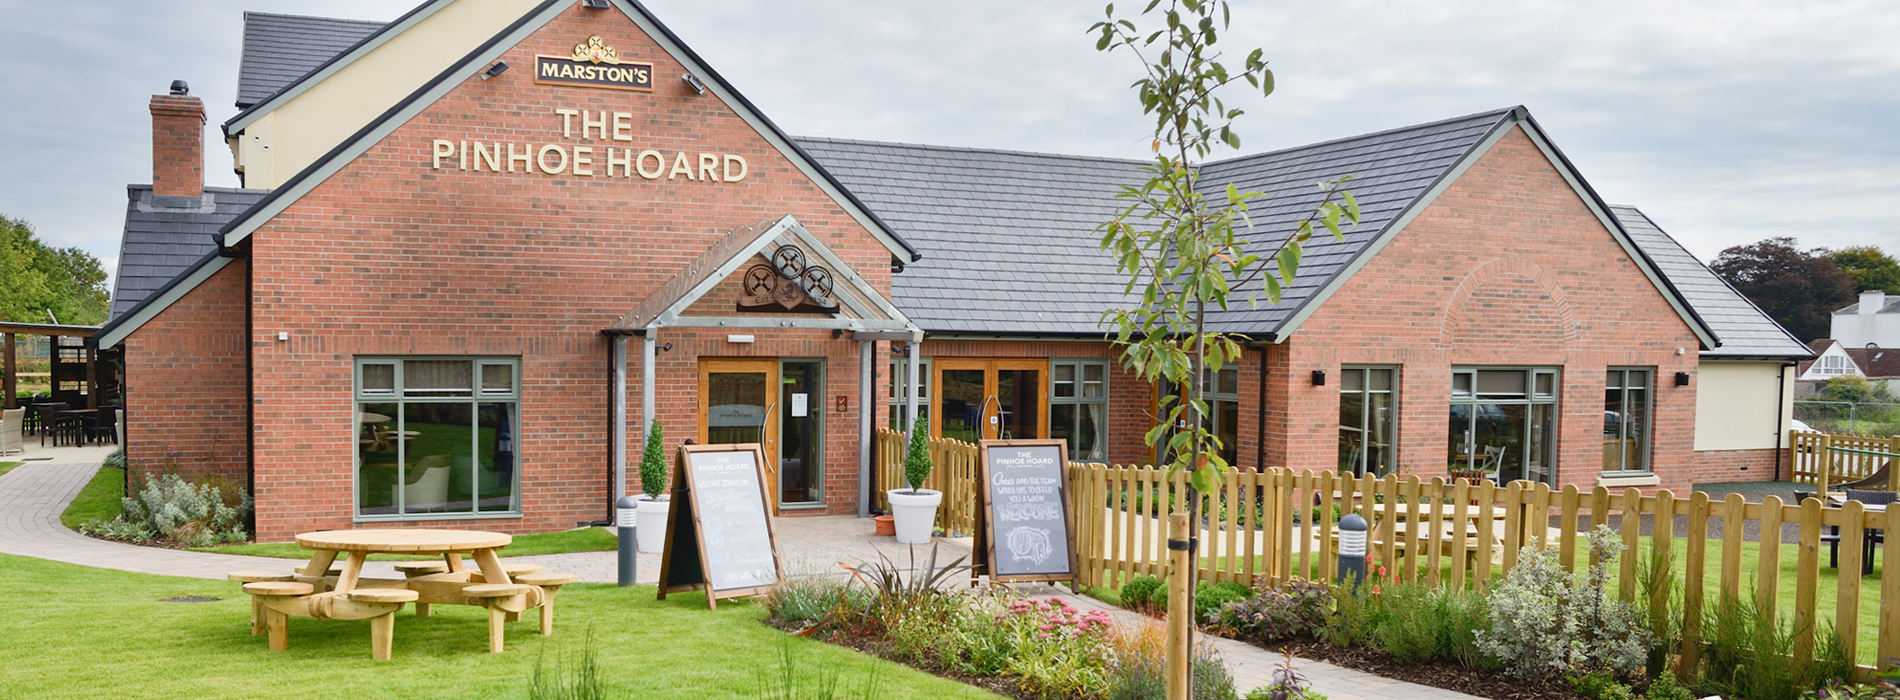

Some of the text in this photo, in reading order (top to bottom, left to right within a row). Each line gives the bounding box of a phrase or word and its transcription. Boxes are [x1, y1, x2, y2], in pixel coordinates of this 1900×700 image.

[541, 62, 648, 84] MARSTON'S
[556, 109, 633, 141] THE
[433, 139, 748, 182] PINHOE HOARD
[698, 464, 725, 472] PINHOE
[725, 463, 750, 471] HOARD
[1016, 477, 1029, 485] AND
[1040, 477, 1056, 485] TEAM
[997, 486, 1016, 494] WOULD
[1028, 486, 1036, 494] TO
[1035, 486, 1053, 494] OFFER
[1008, 495, 1021, 503] YOU
[997, 501, 1060, 522] WELCOME
